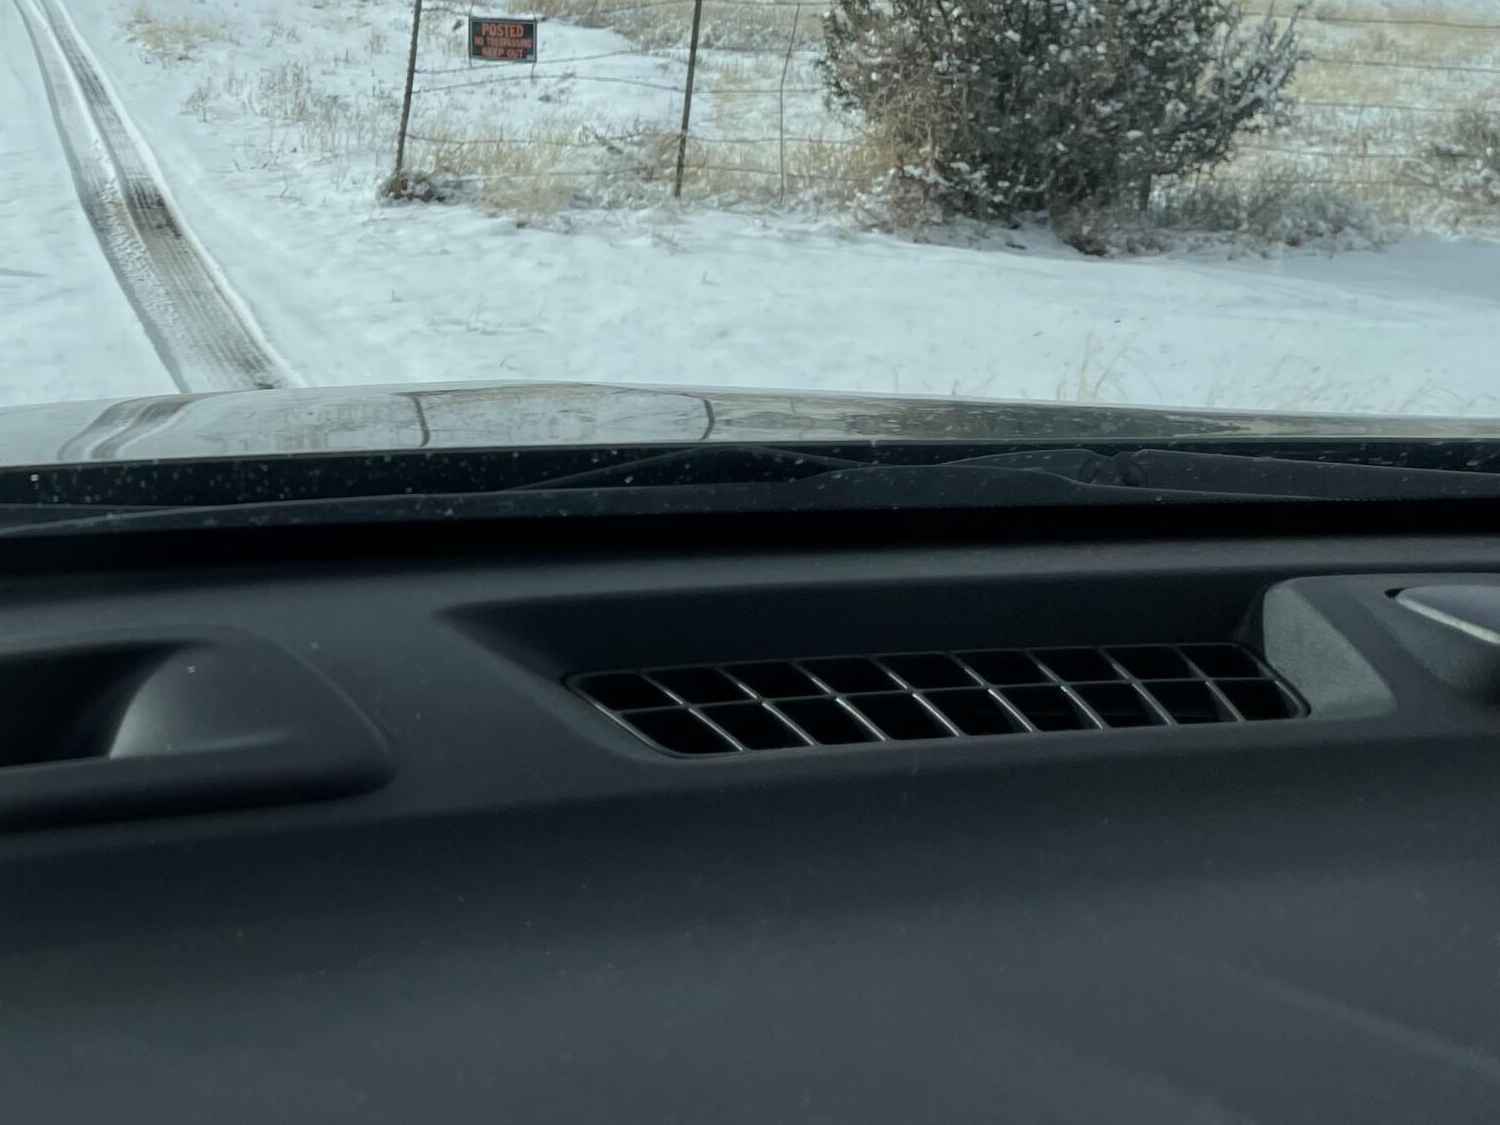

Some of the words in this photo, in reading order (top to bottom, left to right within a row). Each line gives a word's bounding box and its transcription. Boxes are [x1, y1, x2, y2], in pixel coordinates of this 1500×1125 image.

[482, 23, 524, 37] POSTED
[474, 36, 484, 45] NO
[482, 47, 504, 56] KEEP
[507, 49, 523, 59] OUT
